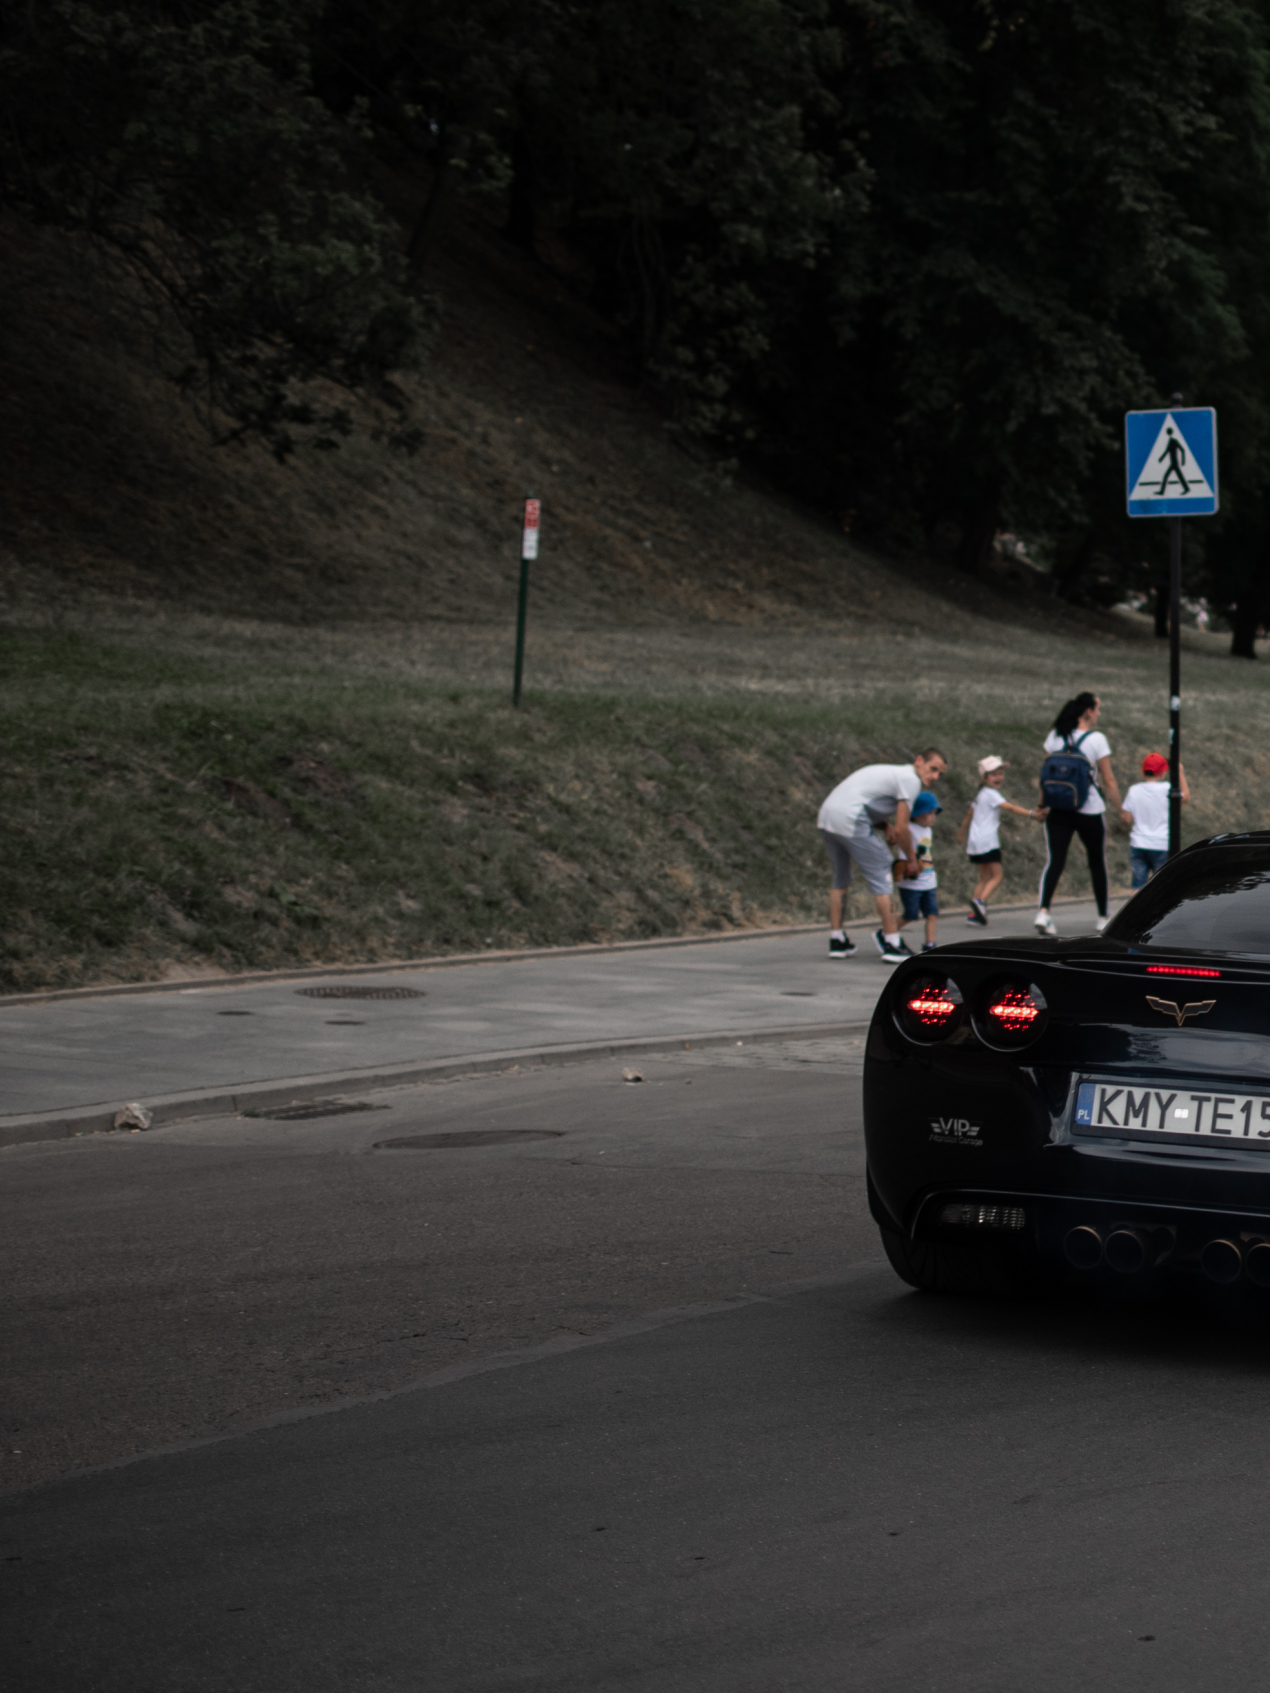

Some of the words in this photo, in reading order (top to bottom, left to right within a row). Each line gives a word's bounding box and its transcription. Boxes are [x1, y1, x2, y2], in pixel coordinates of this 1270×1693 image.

[1077, 1109, 1090, 1120] PL
[1097, 1088, 1177, 1129] KMY
[939, 1117, 970, 1136] VIP
